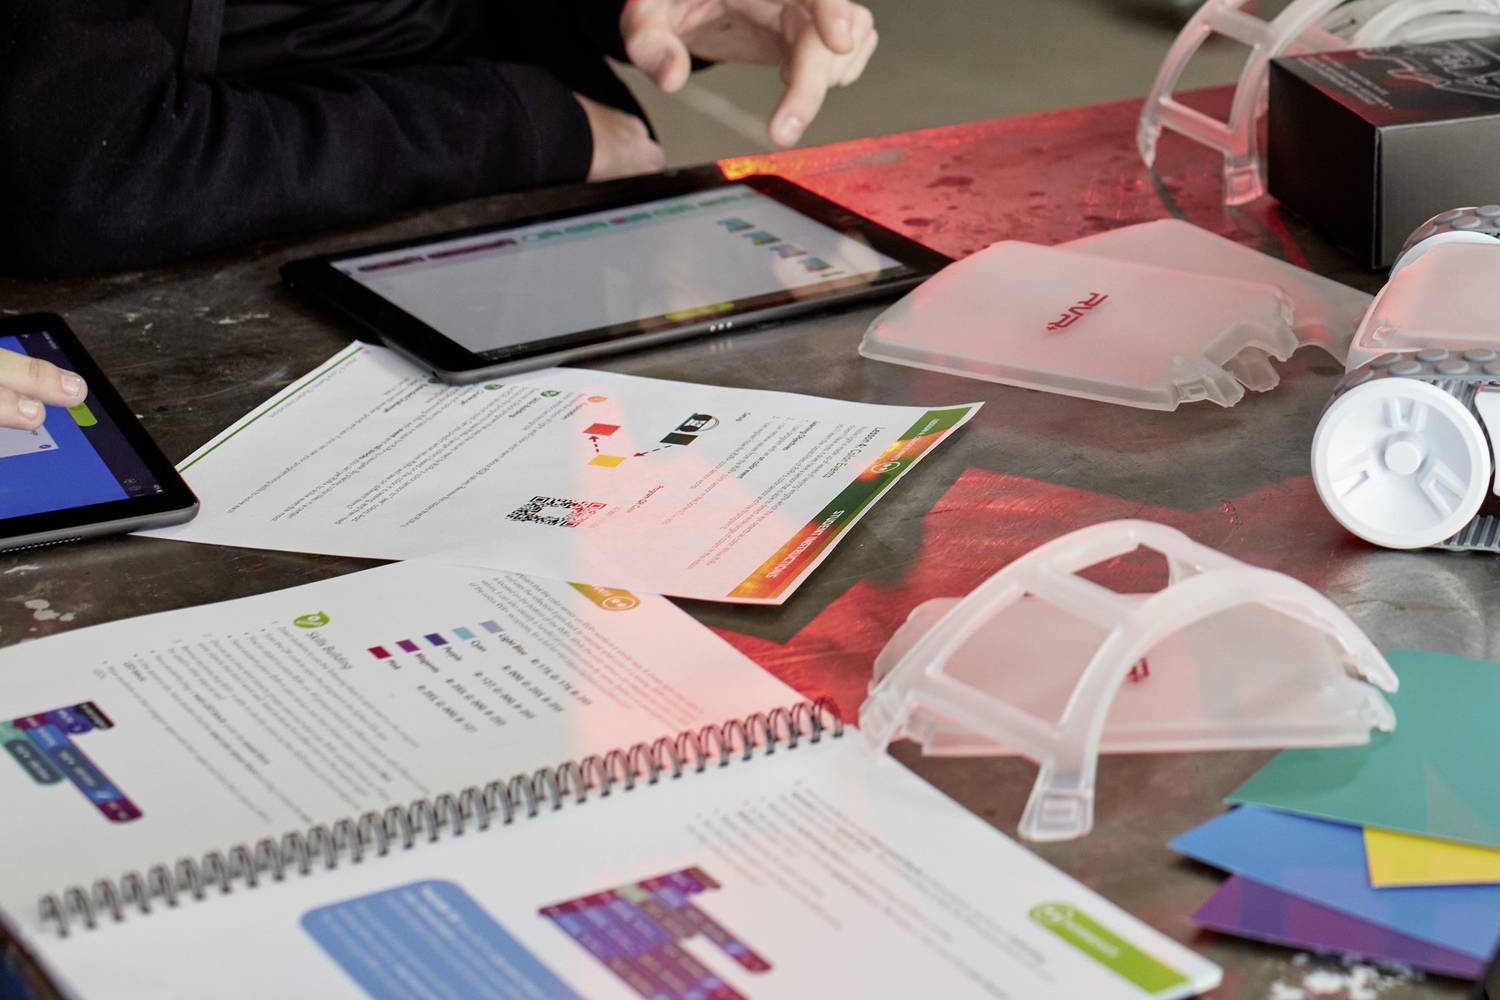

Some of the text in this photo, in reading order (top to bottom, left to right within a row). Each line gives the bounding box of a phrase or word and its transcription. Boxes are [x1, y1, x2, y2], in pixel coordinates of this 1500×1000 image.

[1046, 292, 1109, 331] RVR+
[859, 426, 886, 443] Lesson
[838, 448, 862, 462] Color
[820, 462, 847, 478] Events
[763, 509, 845, 578] STUDENT INSTRUCTIONS
